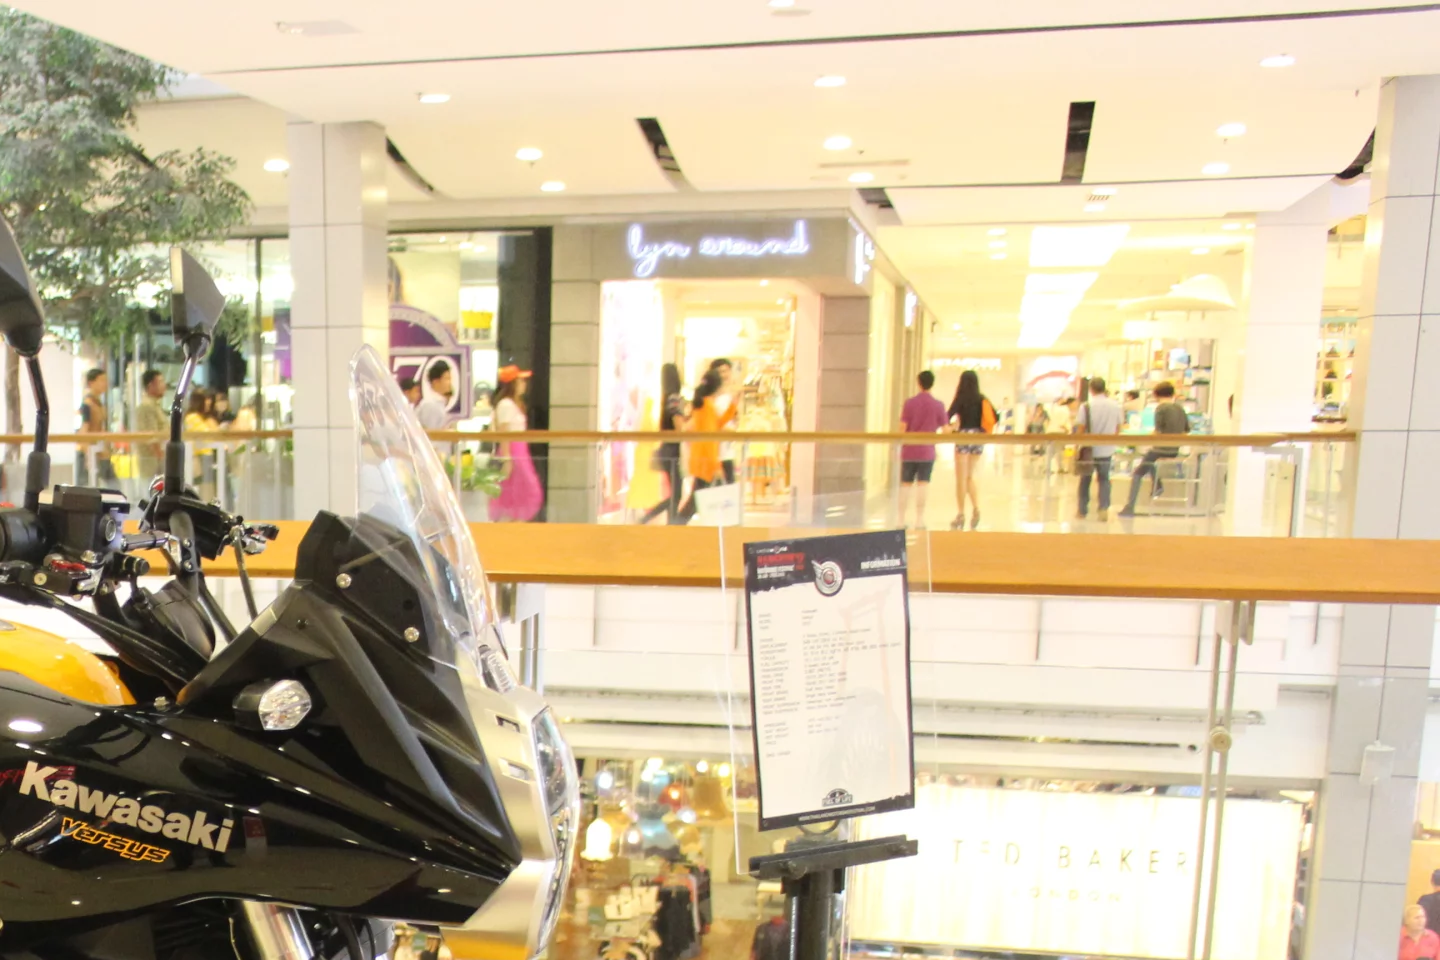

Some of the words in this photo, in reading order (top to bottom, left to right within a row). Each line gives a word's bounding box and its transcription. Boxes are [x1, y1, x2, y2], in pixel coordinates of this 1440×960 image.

[860, 558, 901, 570] INFORMATION
[19, 761, 235, 852] Kawasaki
[1058, 845, 1188, 876] BAKER
[1012, 885, 1122, 902] ONDON
